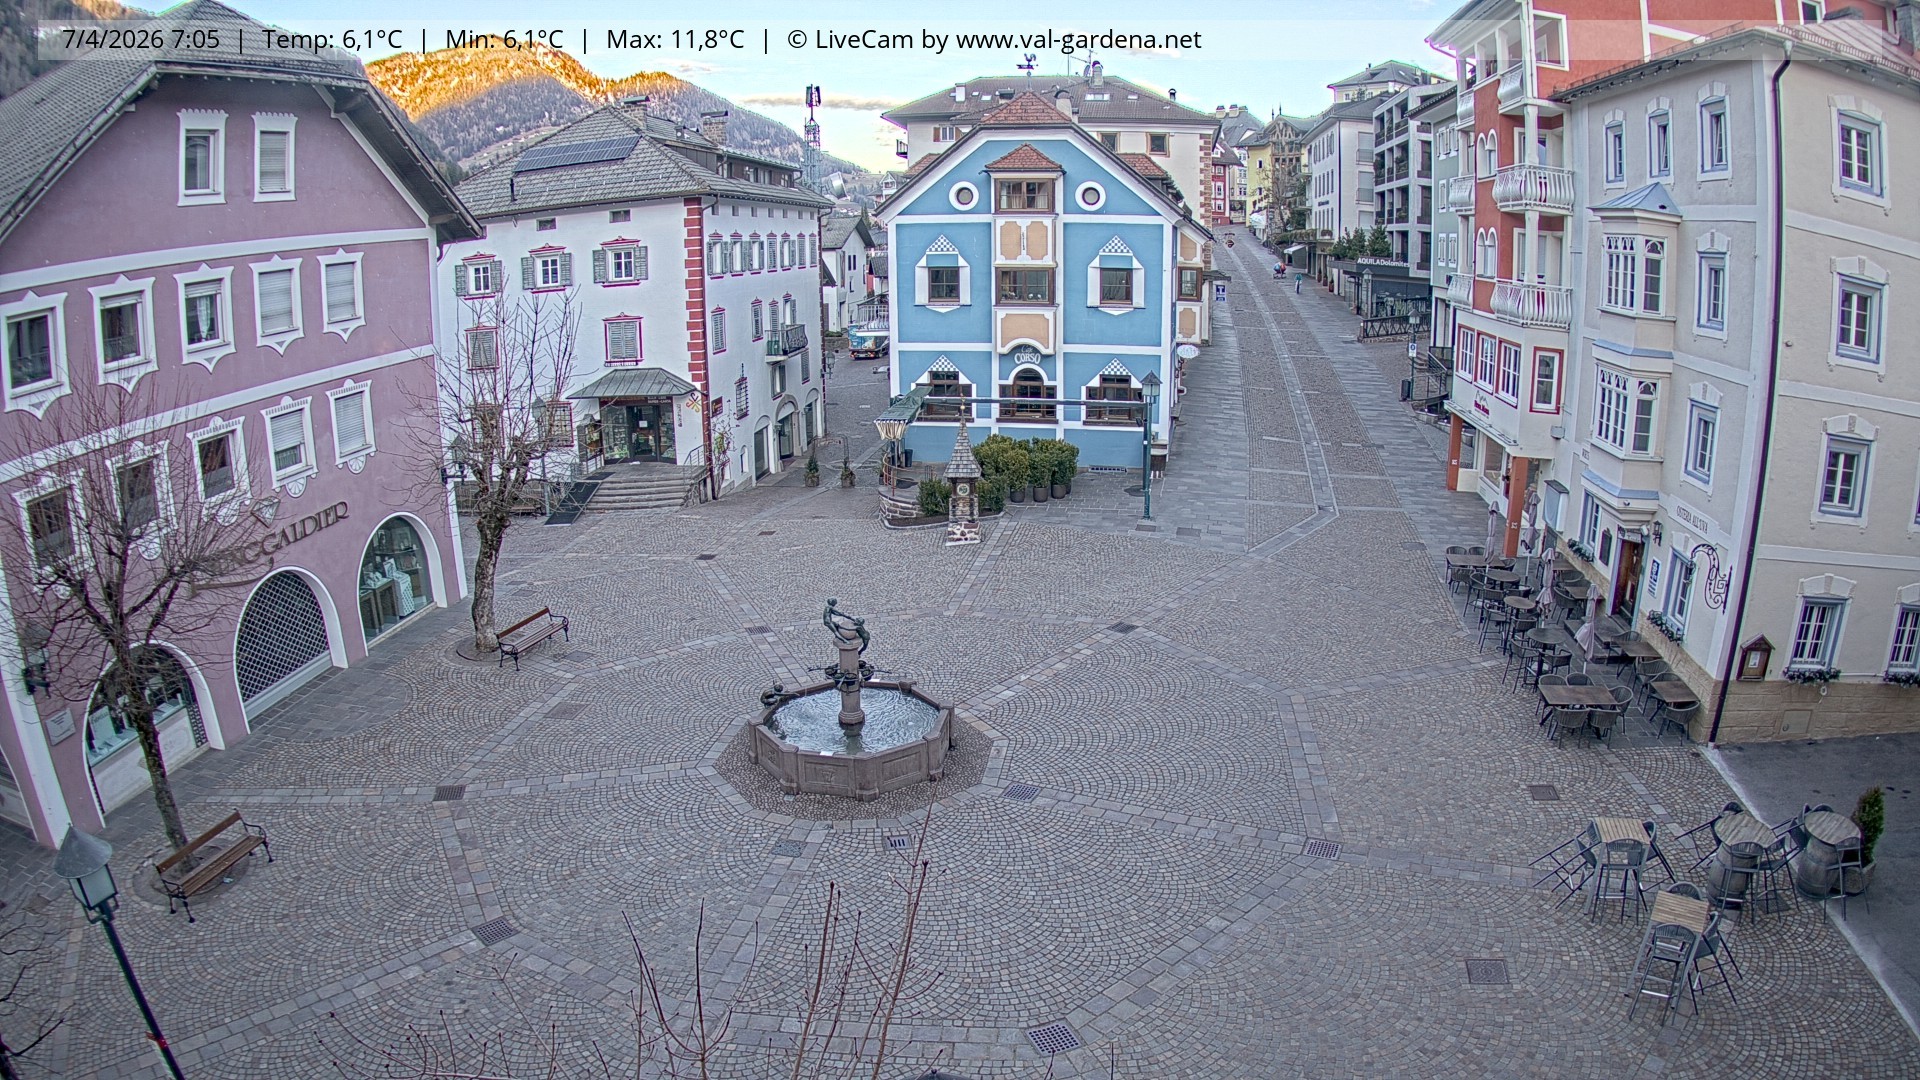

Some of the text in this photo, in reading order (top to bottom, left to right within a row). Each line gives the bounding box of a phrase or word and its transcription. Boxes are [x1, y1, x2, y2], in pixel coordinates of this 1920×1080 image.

[1357, 257, 1410, 268] AQUILA Dolomites
[1014, 352, 1041, 365] CORSO
